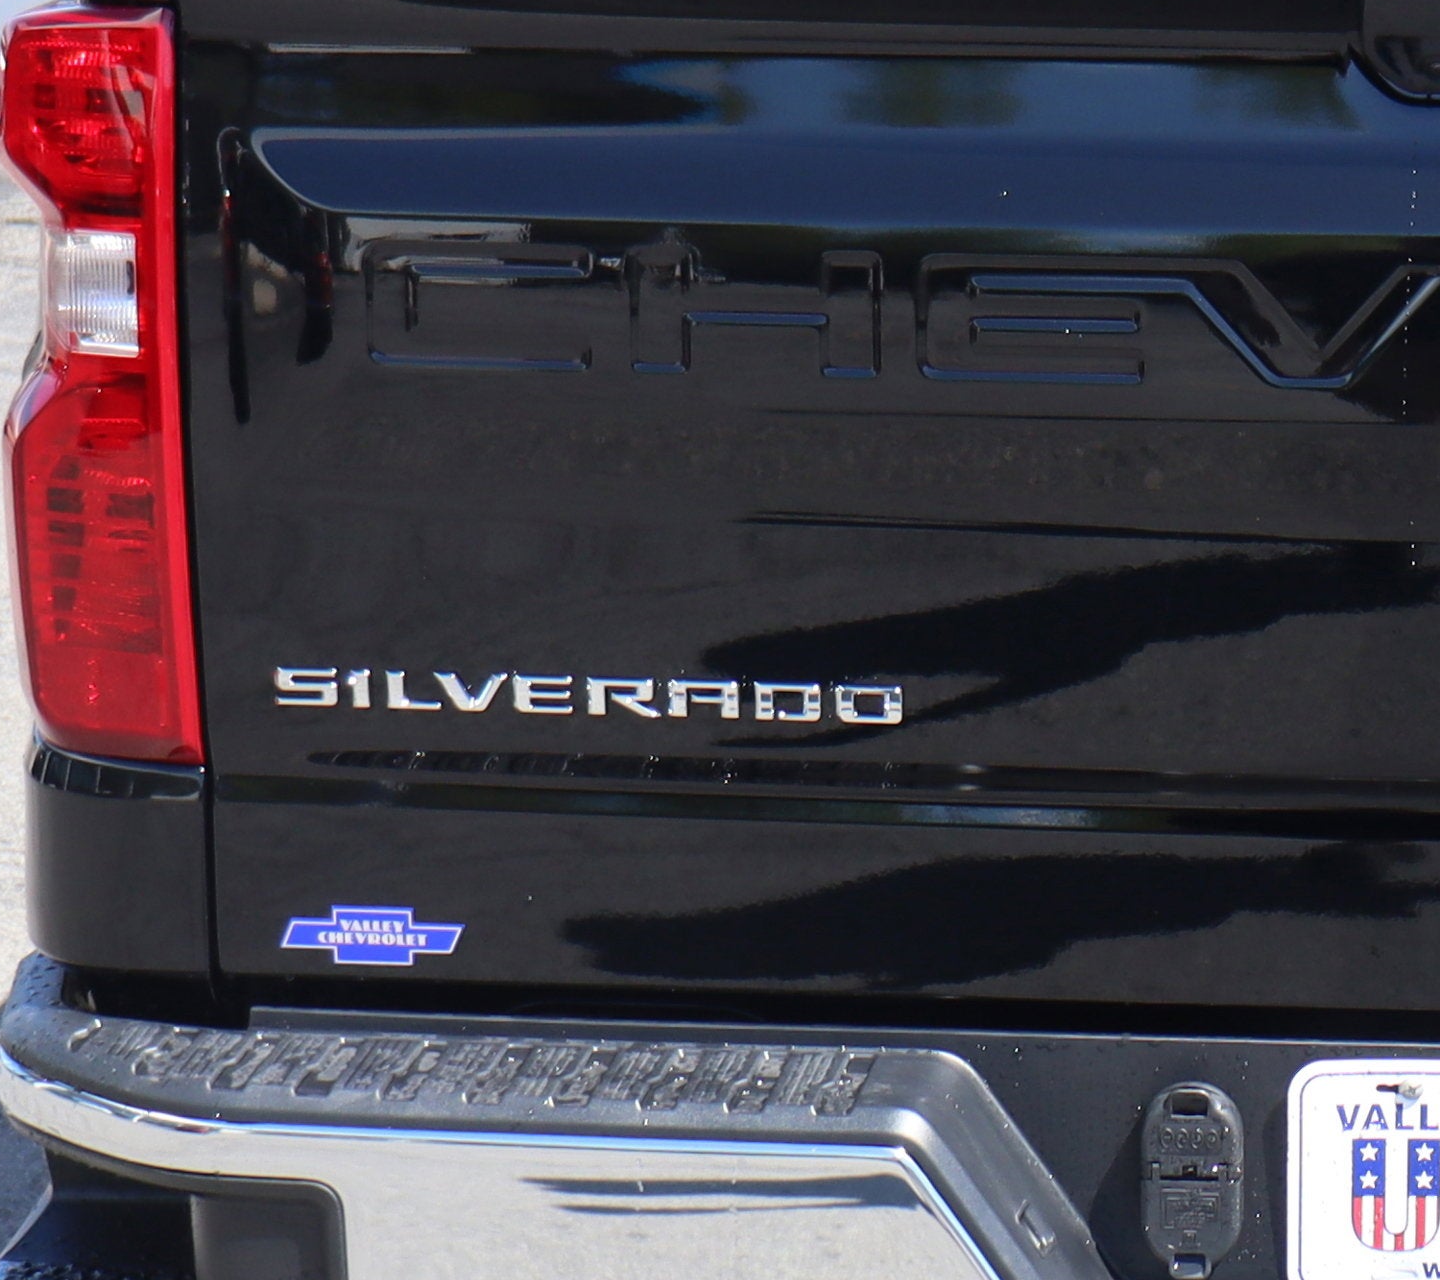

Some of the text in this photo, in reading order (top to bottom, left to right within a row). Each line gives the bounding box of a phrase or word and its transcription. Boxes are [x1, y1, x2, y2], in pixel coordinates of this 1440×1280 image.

[274, 666, 904, 725] SILVERADO
[339, 919, 405, 933] VALLEY
[317, 931, 428, 947] CHEVROLET
